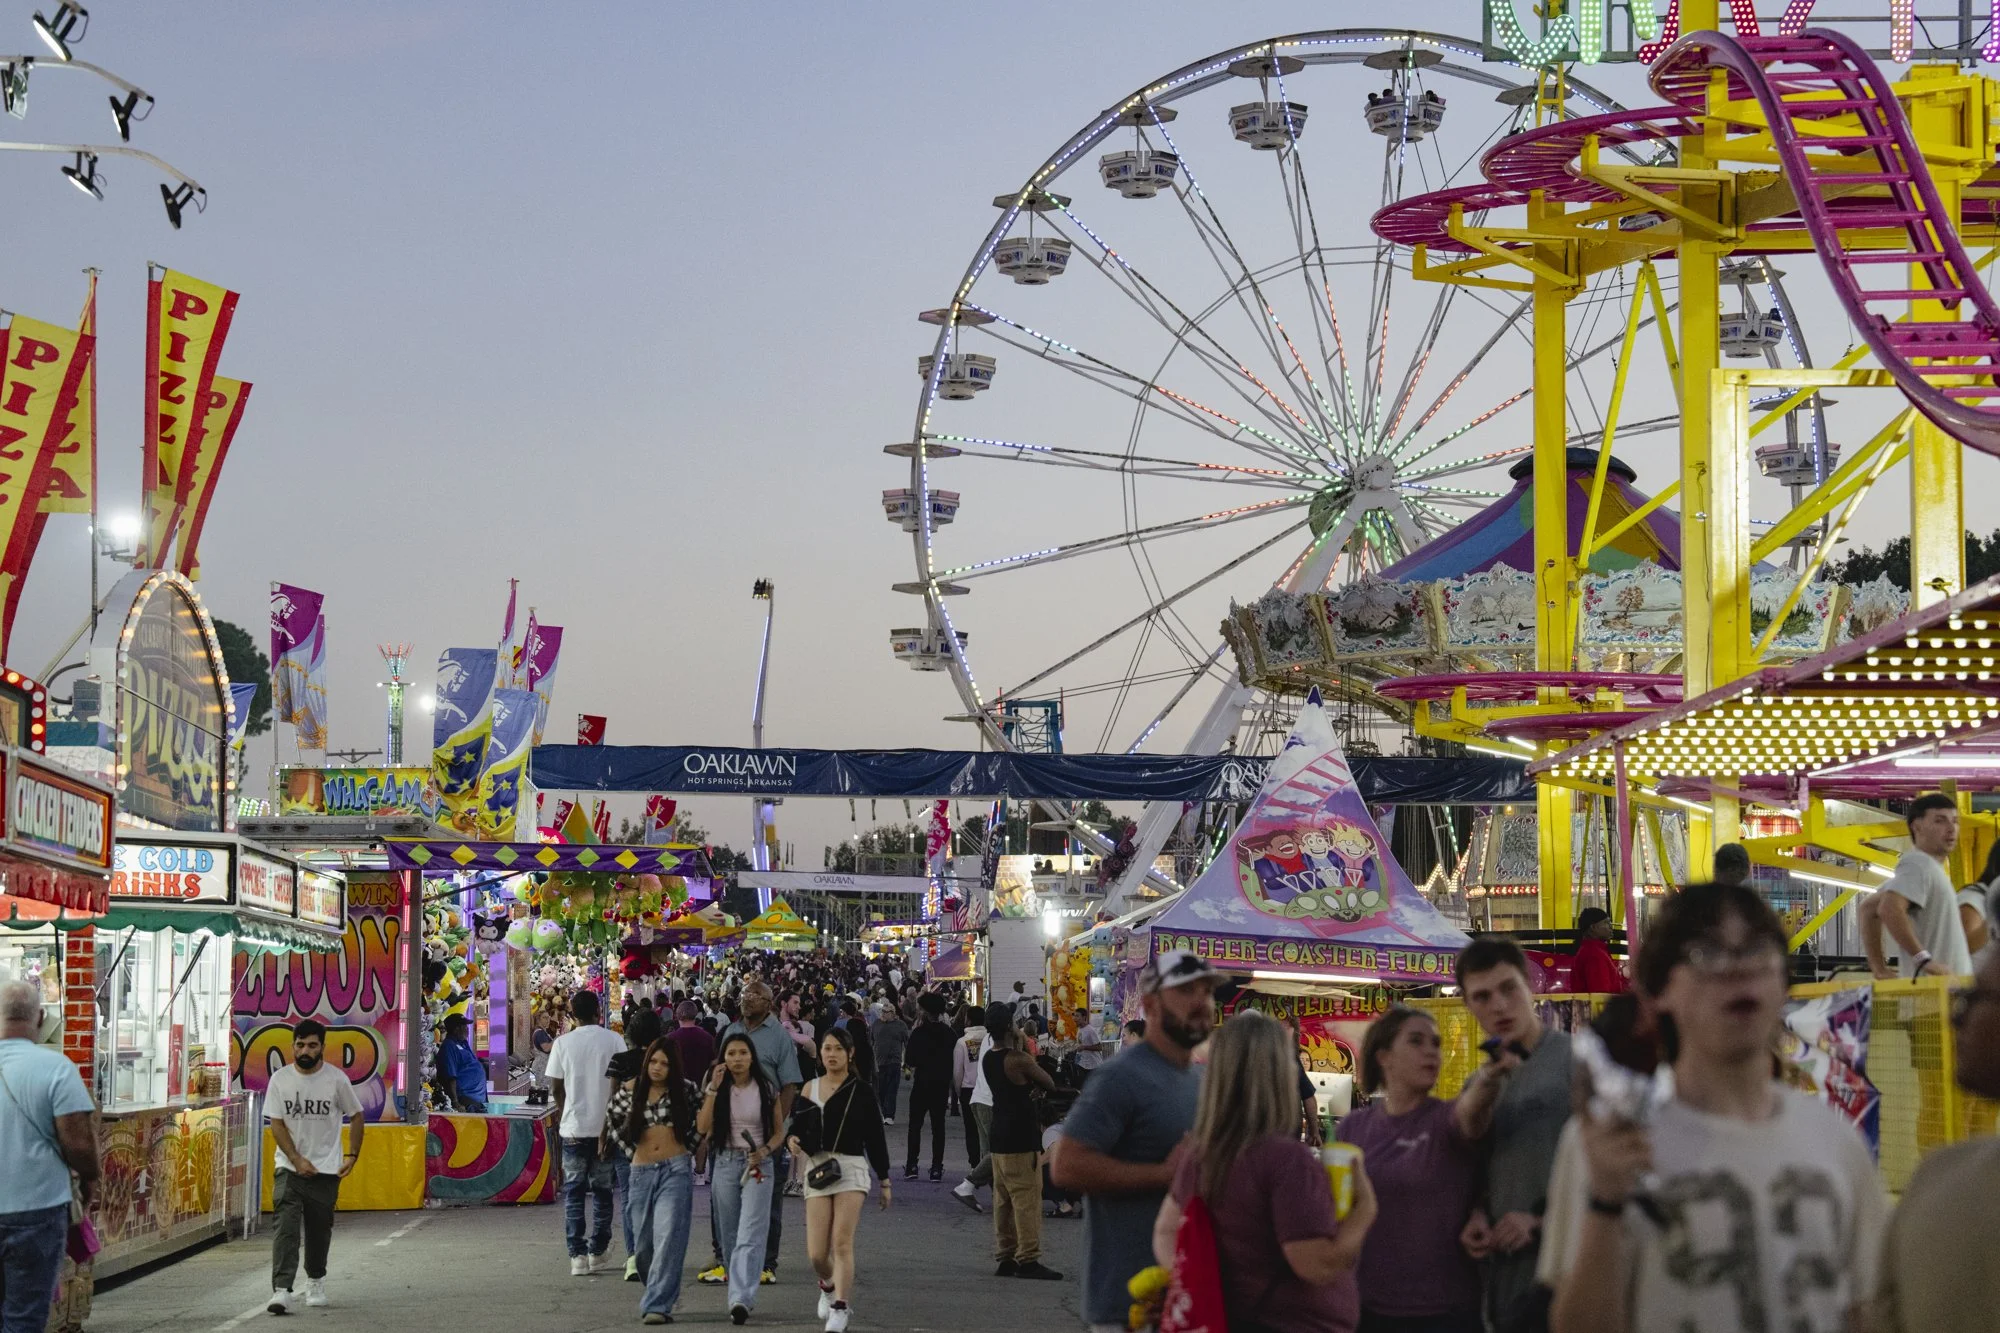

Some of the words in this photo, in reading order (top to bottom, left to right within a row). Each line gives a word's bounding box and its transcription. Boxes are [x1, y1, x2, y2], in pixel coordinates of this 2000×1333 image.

[683, 753, 797, 776] OAKLAWN
[322, 772, 446, 818] WHAC-A-MO
[707, 777, 747, 786] SPRINGS,
[748, 778, 793, 786] ARKANSAS
[15, 775, 61, 841] CHICKEN
[62, 790, 104, 855] TENDERS
[138, 846, 214, 873] COLD
[109, 871, 202, 898] RINKS
[813, 875, 855, 885] OAKLAWN
[347, 882, 401, 907] WIN
[233, 914, 402, 1018] LLOON
[1155, 933, 1258, 962] ROLLER
[1266, 940, 1378, 970] COASTER
[1386, 950, 1456, 975] PHOT
[284, 1091, 332, 1119] PARIS
